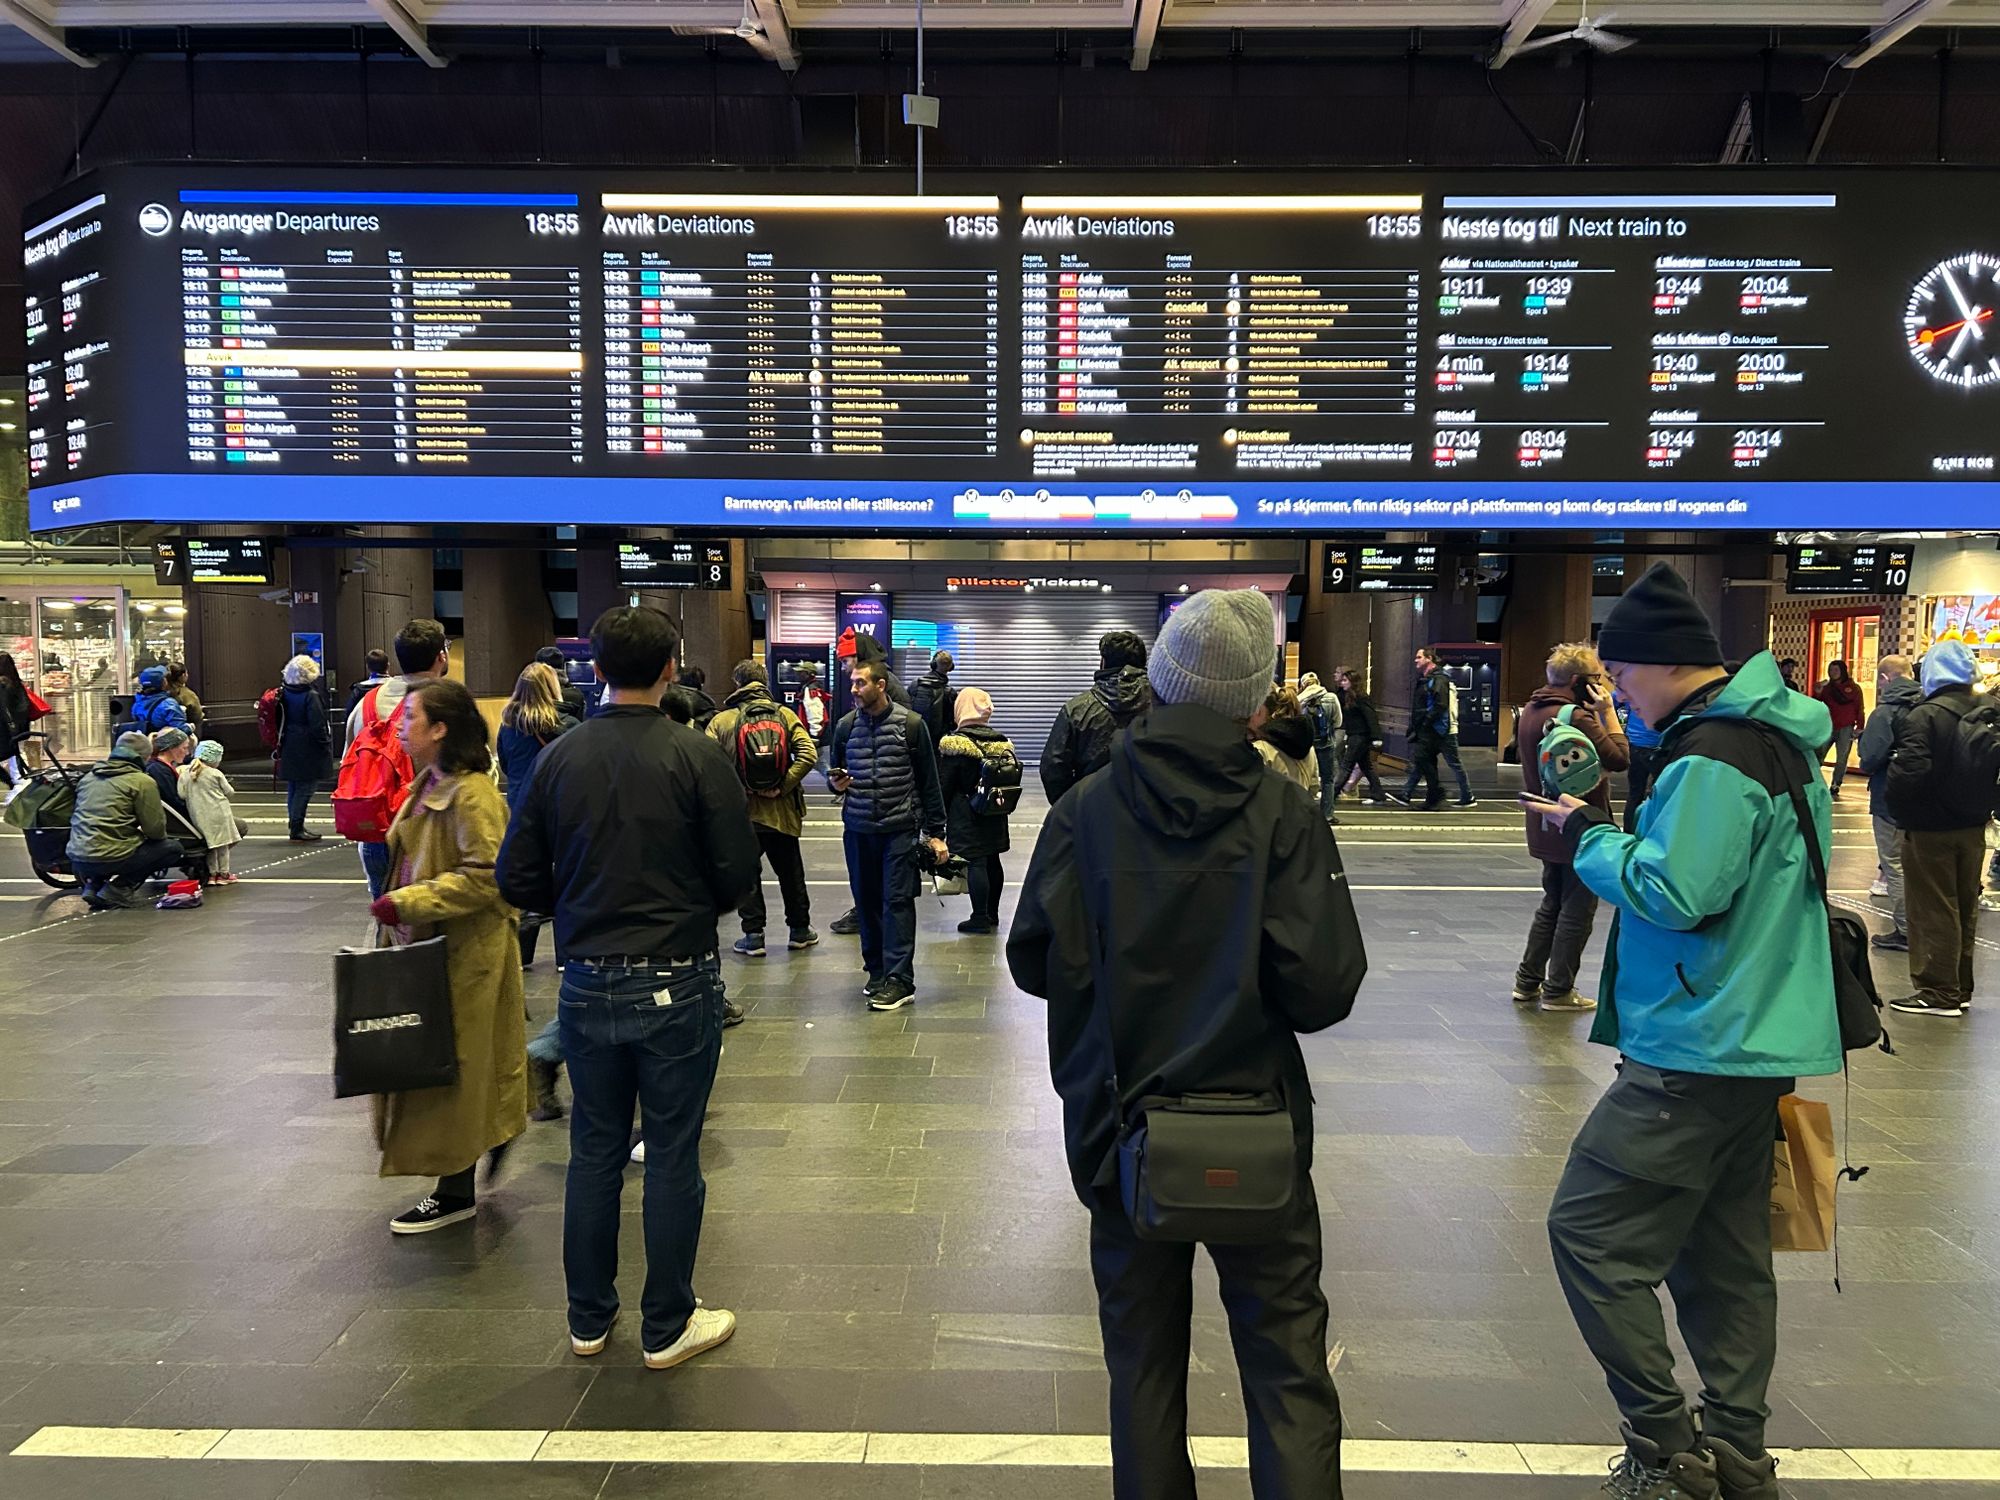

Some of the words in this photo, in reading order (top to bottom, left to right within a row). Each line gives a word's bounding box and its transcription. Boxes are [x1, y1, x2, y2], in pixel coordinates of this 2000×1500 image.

[181, 210, 273, 235] Avganger
[275, 212, 379, 234] Departures
[525, 213, 580, 235] 18:55
[602, 213, 655, 235] Avvik
[658, 214, 755, 234] Deviations
[945, 215, 999, 236] 18:55
[1021, 216, 1075, 237] Avvik
[1078, 217, 1175, 236] Deviations
[1366, 215, 1421, 237] 18:55
[1442, 216, 1500, 239] Neste
[1502, 217, 1536, 243] tog
[1539, 215, 1560, 238] til
[1568, 217, 1613, 237] Next
[1617, 216, 1662, 237] train
[1666, 217, 1687, 237] to
[24, 243, 47, 266] Neste
[46, 236, 60, 256] tog
[58, 228, 69, 249] til
[1484, 259, 1544, 269] Nationaltheatret
[1550, 260, 1579, 269] Lysaker
[1708, 259, 1735, 267] Direkte
[1735, 259, 1749, 269] tog
[1755, 259, 1778, 267] Direct
[1779, 259, 1801, 267] trains
[1440, 277, 1484, 295] 19:11
[1527, 277, 1572, 295] 19:39
[1655, 277, 1702, 294] 19:44
[1741, 277, 1789, 294] 20:04
[1098, 287, 1129, 300] Airport
[1165, 302, 1208, 313] Cancelled
[1440, 307, 1454, 316] Spor
[1454, 307, 1462, 315] 7
[1526, 307, 1542, 316] Spor
[1654, 307, 1671, 315] Spor
[1741, 307, 1758, 315] Spor
[1457, 336, 1484, 345] Direkte
[1484, 337, 1498, 346] tog
[1503, 336, 1526, 345] Direct
[1527, 336, 1549, 345] trains
[1652, 333, 1676, 345] Oslo
[1732, 336, 1751, 344] Oslo
[1751, 336, 1778, 346] Airport
[206, 353, 233, 362] Avvik
[1437, 354, 1450, 371] 4
[1452, 354, 1484, 372] min
[1524, 355, 1570, 372] 19:14
[1652, 354, 1698, 371] 19:40
[1737, 354, 1785, 371] 20:00
[1164, 359, 1180, 369] Alt.
[1181, 359, 1220, 371] transport
[748, 371, 764, 381] Alt.
[764, 371, 804, 383] transport
[1076, 387, 1118, 398] Drammen
[1437, 384, 1454, 392] Spor
[1523, 384, 1540, 392] Spor
[1651, 384, 1668, 392] Spor
[1737, 384, 1754, 392] Spor
[1097, 402, 1127, 414] Airport
[1034, 430, 1075, 443] Important
[1075, 432, 1114, 443] message
[1237, 430, 1291, 441] Hovedbanen
[1435, 430, 1481, 448] 07:04
[1520, 430, 1567, 448] 08:04
[1648, 430, 1696, 448] 19:44
[1734, 430, 1782, 448] 20:14
[1435, 459, 1452, 468] Spor
[1520, 459, 1537, 468] Spor
[1648, 459, 1664, 468] Spor
[1664, 459, 1673, 467] 11
[1734, 459, 1750, 468] Spor
[1751, 459, 1760, 467] 11
[1967, 457, 1994, 469] NOR
[724, 496, 792, 513] Barnevogn,
[794, 497, 842, 511] rullestol
[843, 498, 870, 511] eller
[871, 497, 934, 512] stillesone?
[1258, 499, 1274, 513] Se
[1275, 498, 1292, 515] på
[1293, 498, 1351, 516] skjermen,
[1353, 498, 1378, 513] finn
[1379, 499, 1412, 515] riktig
[1413, 499, 1451, 513] sektor
[1452, 498, 1469, 515] på
[1471, 499, 1543, 516] plattformen
[1544, 502, 1561, 515] og
[1563, 499, 1590, 513] kom
[1592, 499, 1616, 515] deg
[1618, 499, 1662, 513] raskere
[1663, 499, 1677, 513] til
[1678, 502, 1725, 515] vognen
[1726, 499, 1747, 513] din
[241, 549, 262, 557] 19:11
[706, 548, 721, 556] Spor
[1890, 552, 1906, 560] Spor
[163, 560, 174, 576] 7
[1853, 557, 1875, 566] 18:16
[710, 565, 721, 581] 8
[1332, 568, 1344, 584] 9
[1885, 569, 1907, 586] 10
[1028, 577, 1099, 588] Tickets
